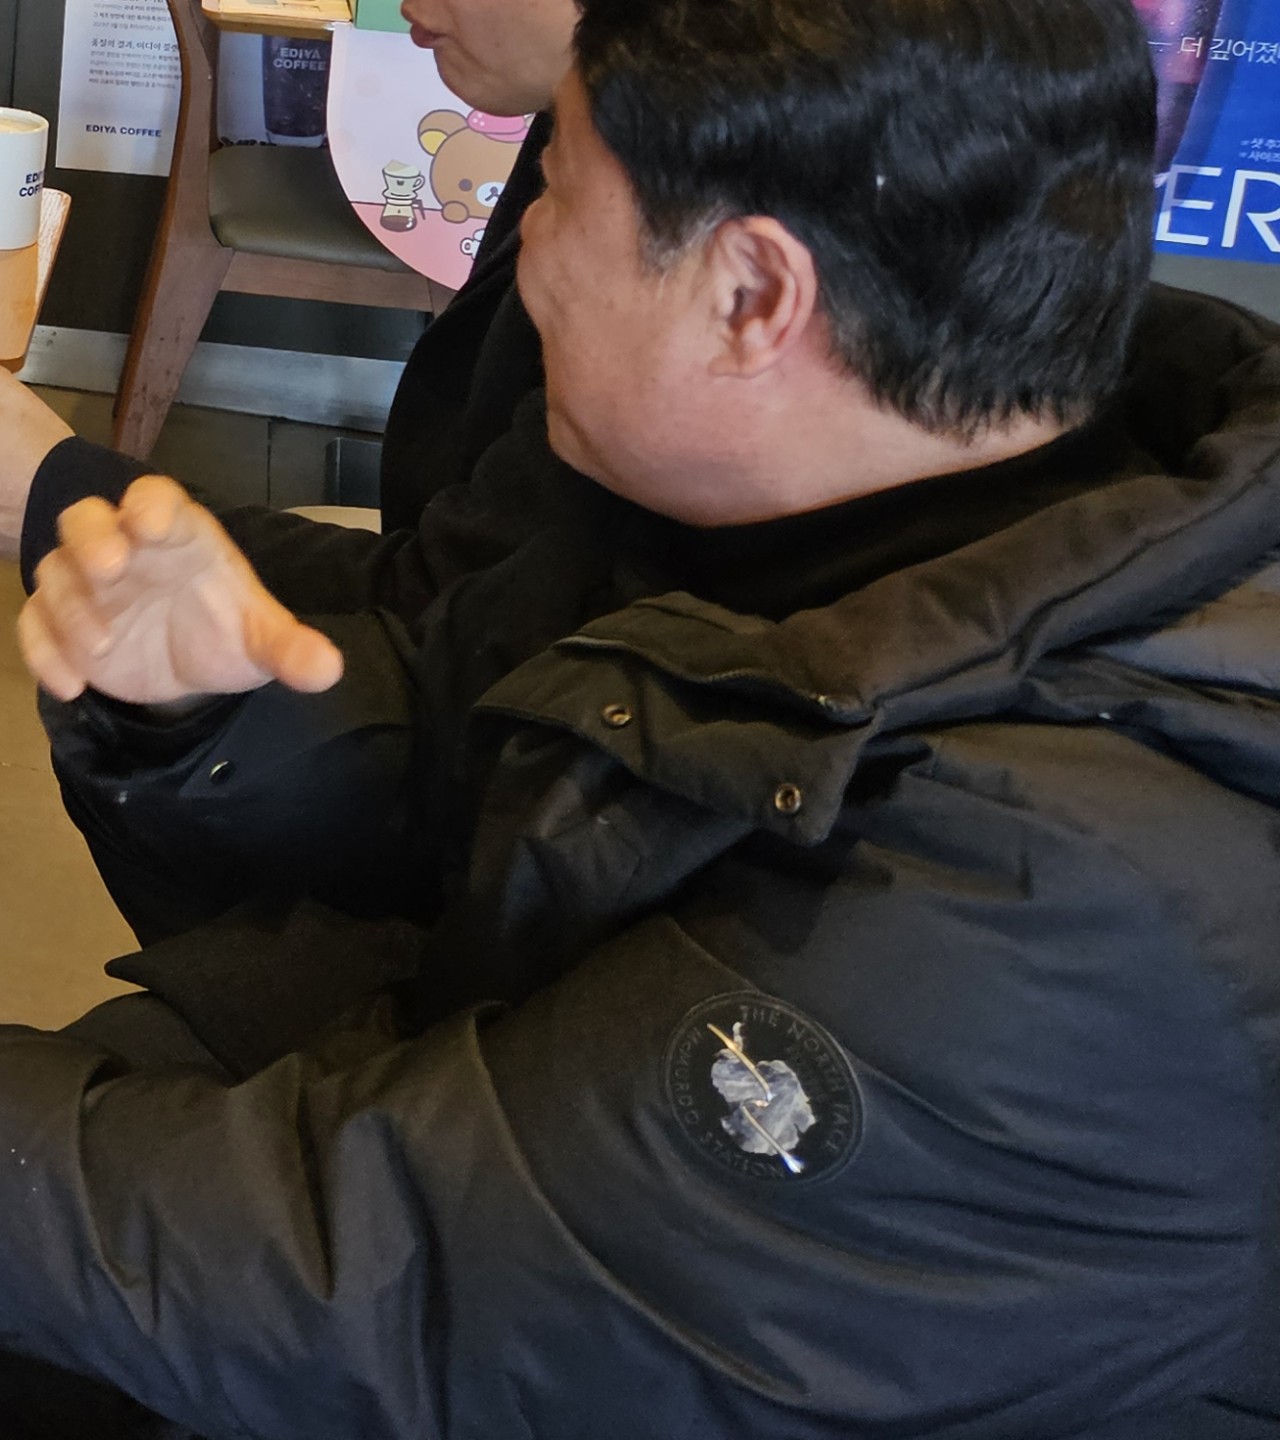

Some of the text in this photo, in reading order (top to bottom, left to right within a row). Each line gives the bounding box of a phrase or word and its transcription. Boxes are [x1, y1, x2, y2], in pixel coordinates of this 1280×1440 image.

[92, 38, 161, 50] 품질의 이디야
[1180, 36, 1203, 58] 더
[280, 47, 321, 59] EDIYA
[273, 58, 326, 71] COFFEE
[86, 124, 162, 137] EDIYA COFFEE
[1154, 164, 1280, 252] ER
